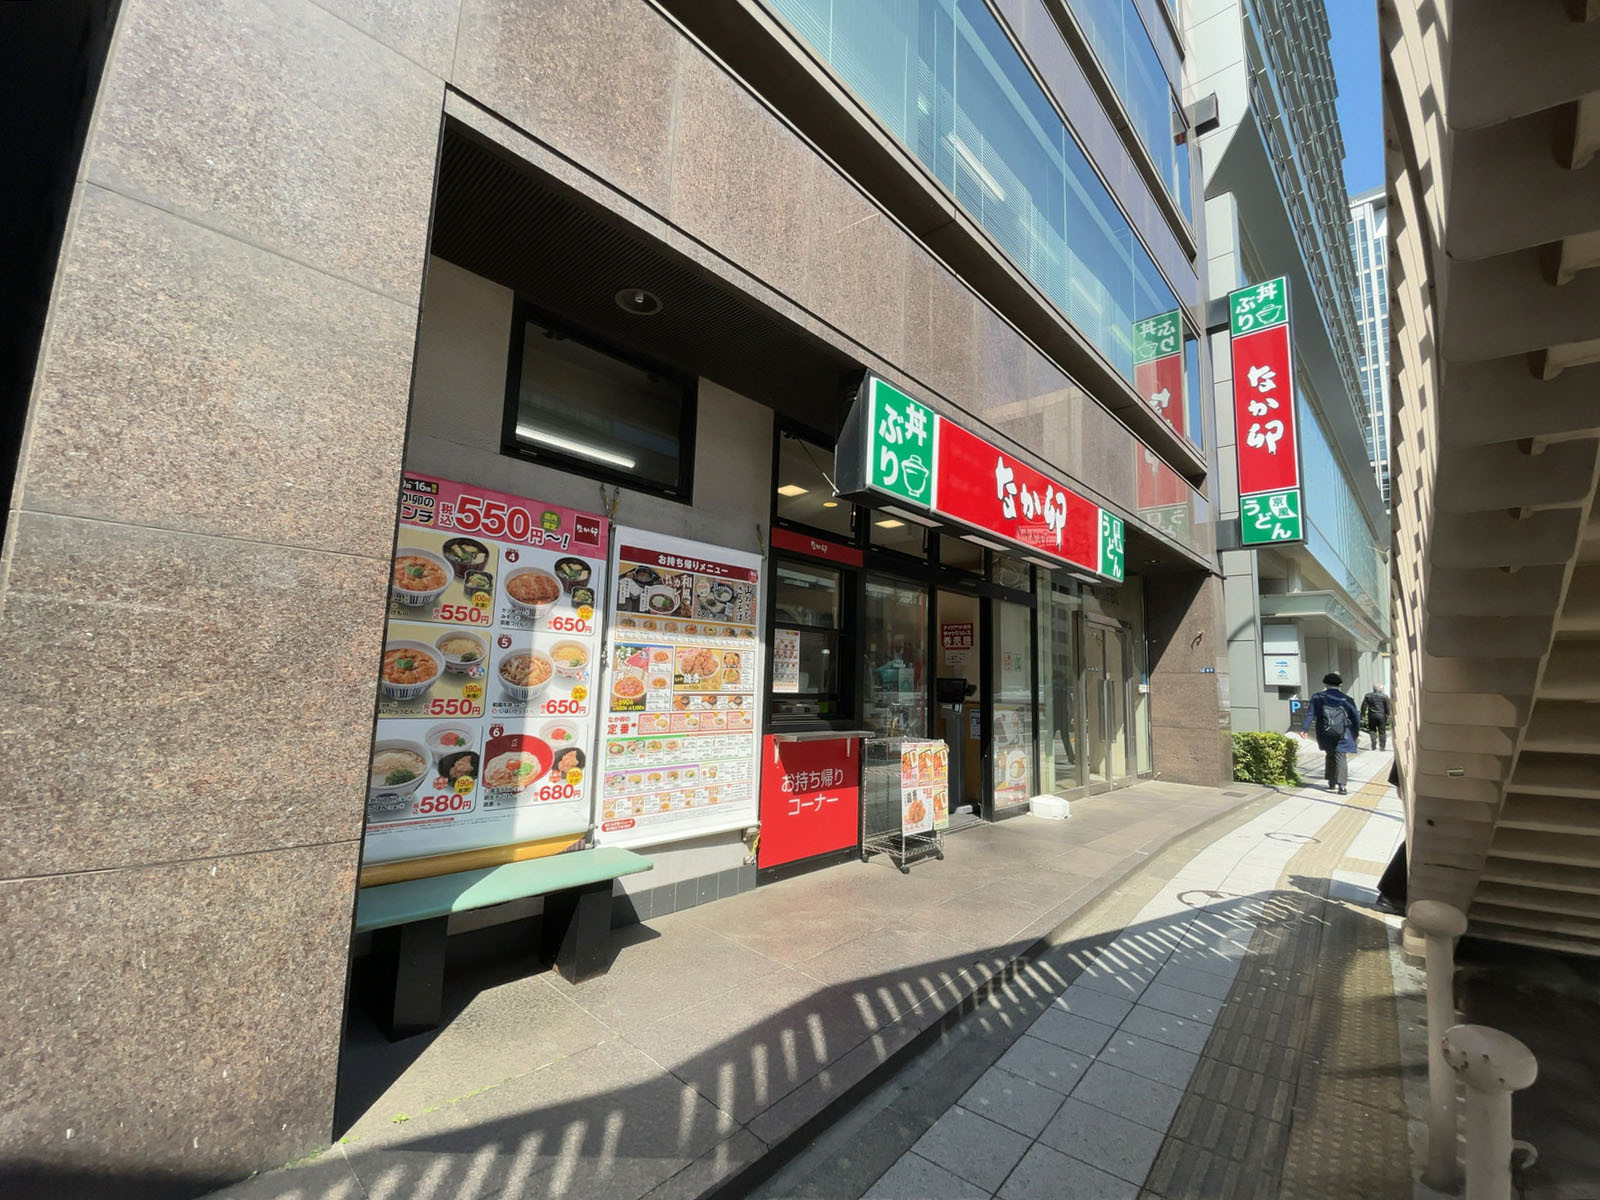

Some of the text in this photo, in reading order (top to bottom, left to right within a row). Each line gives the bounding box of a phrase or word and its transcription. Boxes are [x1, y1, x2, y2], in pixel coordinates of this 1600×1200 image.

[1247, 365, 1284, 455] なか卯
[996, 455, 1067, 552] なか卯
[508, 553, 516, 562] 4
[440, 604, 489, 624] 550円
[553, 616, 592, 633] 650円
[501, 638, 509, 648] 5
[430, 698, 480, 716] 550円
[546, 699, 587, 715] 650円
[1291, 701, 1302, 713] P
[493, 728, 500, 737] 6
[781, 768, 844, 792] お持ち帰り
[540, 784, 581, 802] 680円
[420, 793, 472, 814] 580円
[787, 793, 839, 816] コーナー
